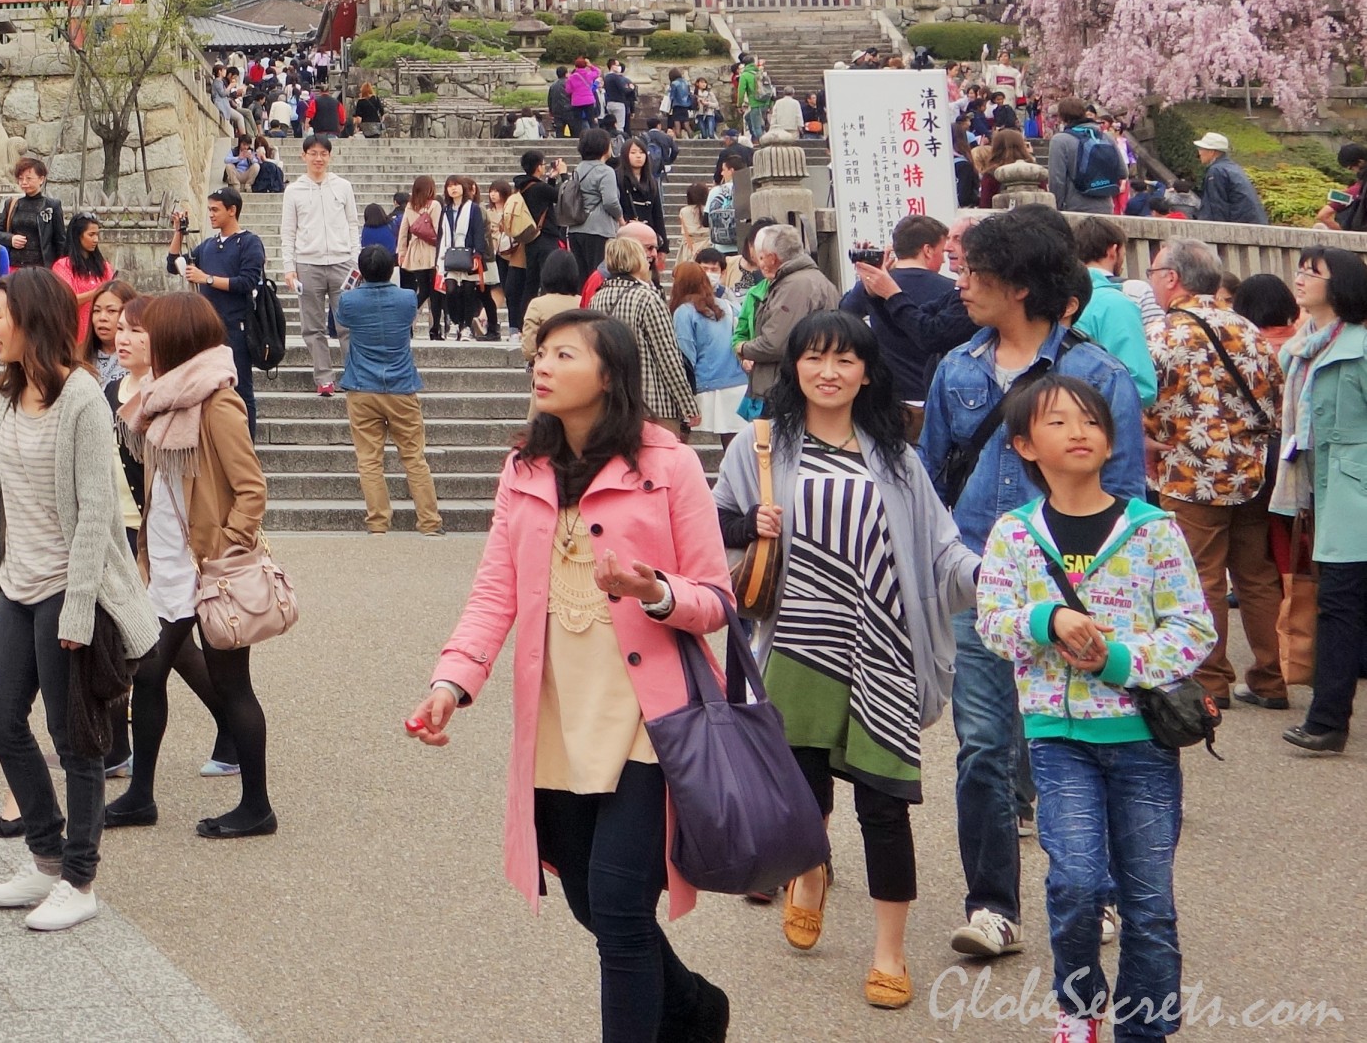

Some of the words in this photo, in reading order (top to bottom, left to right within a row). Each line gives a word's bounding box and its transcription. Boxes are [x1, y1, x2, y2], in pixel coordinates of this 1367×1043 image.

[920, 87, 942, 158] 清水寺
[899, 108, 926, 217] 夜の特別
[1090, 594, 1102, 604] TK
[1103, 596, 1132, 609] SAPKID
